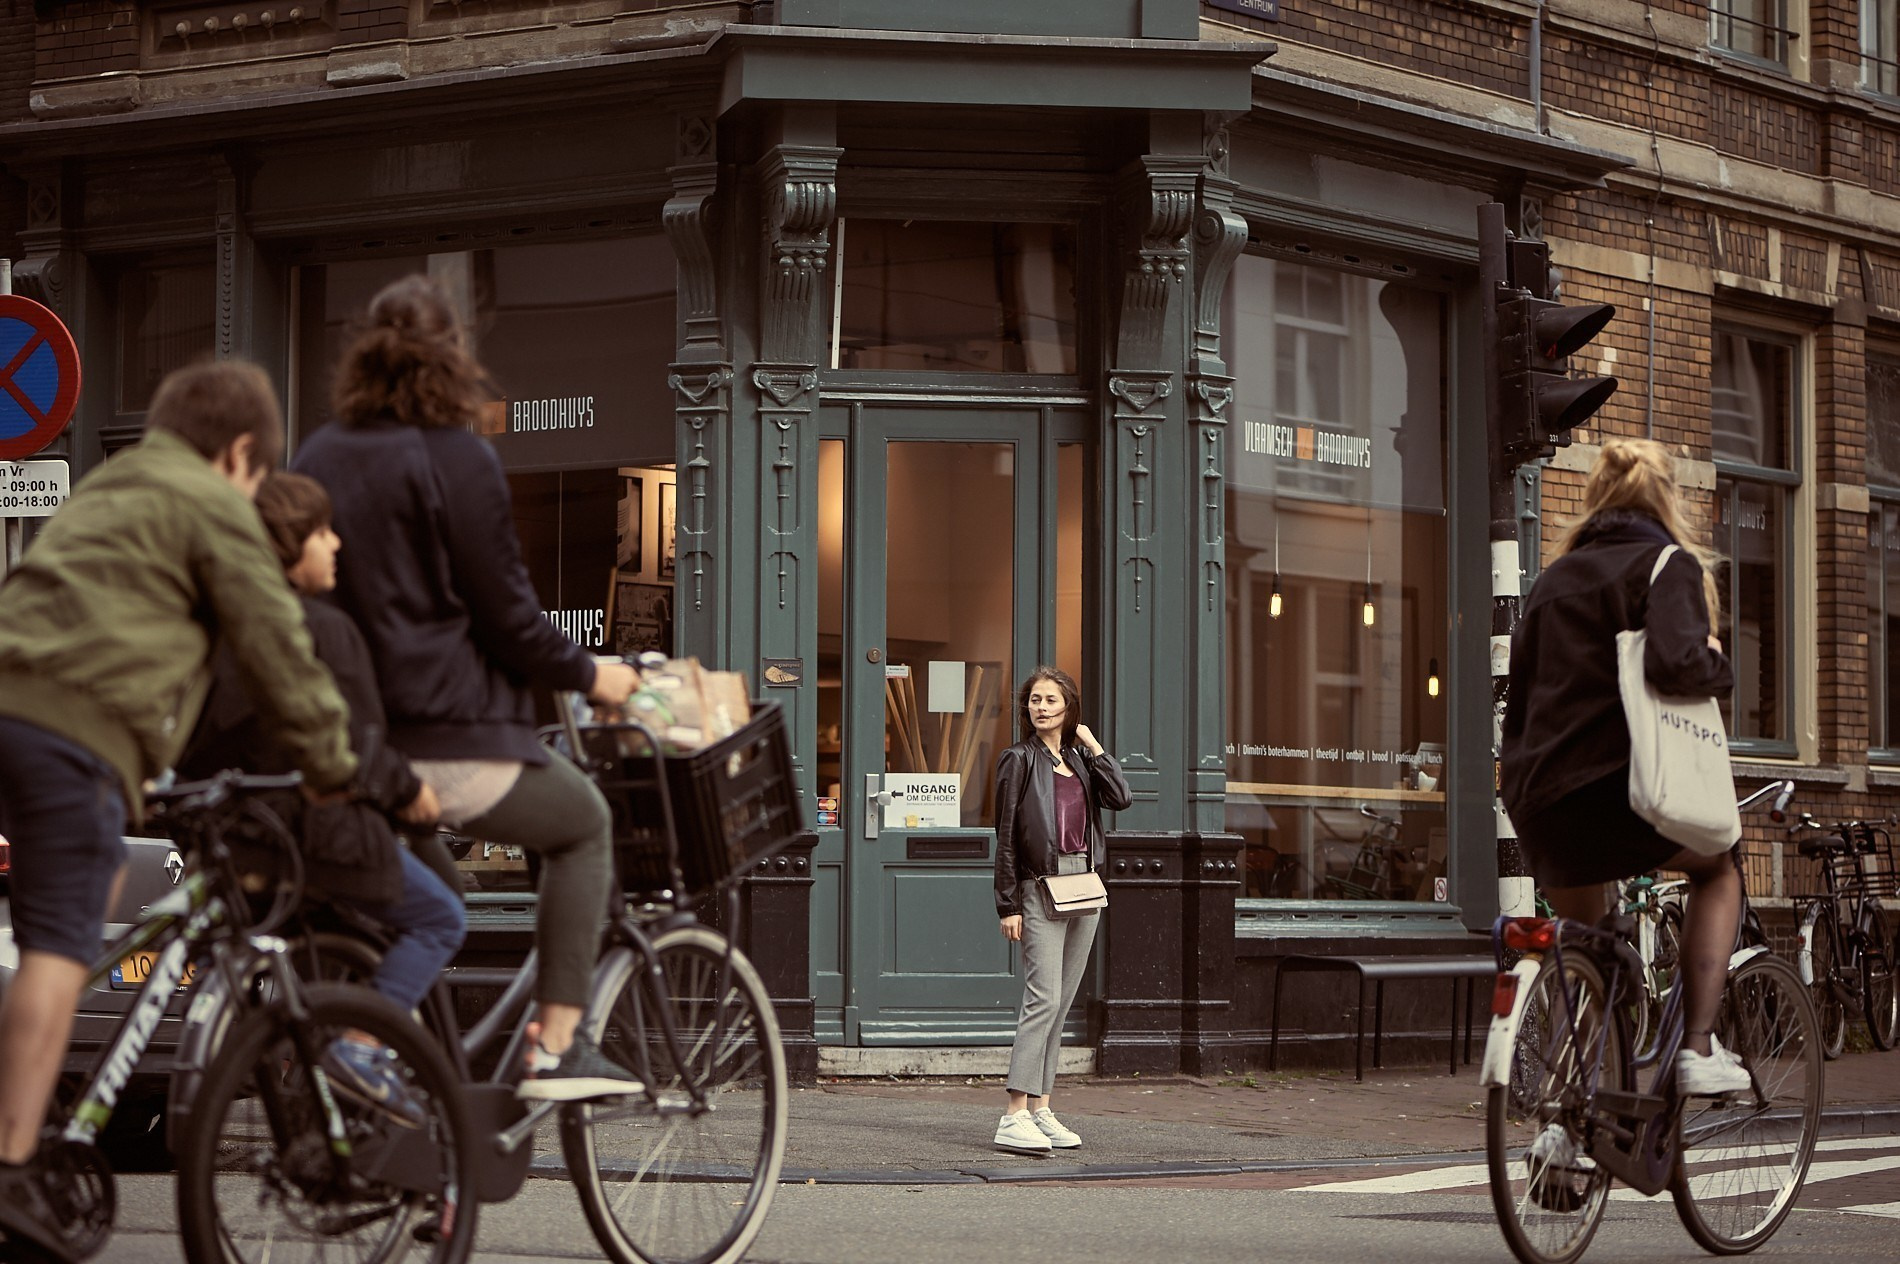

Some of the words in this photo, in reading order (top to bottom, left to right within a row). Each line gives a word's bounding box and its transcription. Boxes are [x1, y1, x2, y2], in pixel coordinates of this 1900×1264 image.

[1239, 0, 1273, 13] CENTRUM
[513, 396, 594, 432] BROODHUYS
[1244, 420, 1293, 458] VLAAMSCH
[1317, 431, 1371, 468] BROODHUYS
[10, 465, 24, 477] Vr
[10, 480, 46, 492] 09:00
[49, 480, 58, 491] h
[1242, 744, 1267, 756] Dimitri's
[1267, 745, 1309, 758] boterhammen
[1316, 747, 1338, 762] theetijd
[1371, 750, 1388, 762] brood
[906, 784, 957, 794] INGANG
[906, 794, 919, 802] OM
[920, 794, 932, 802] DE
[933, 794, 957, 802] HOEK
